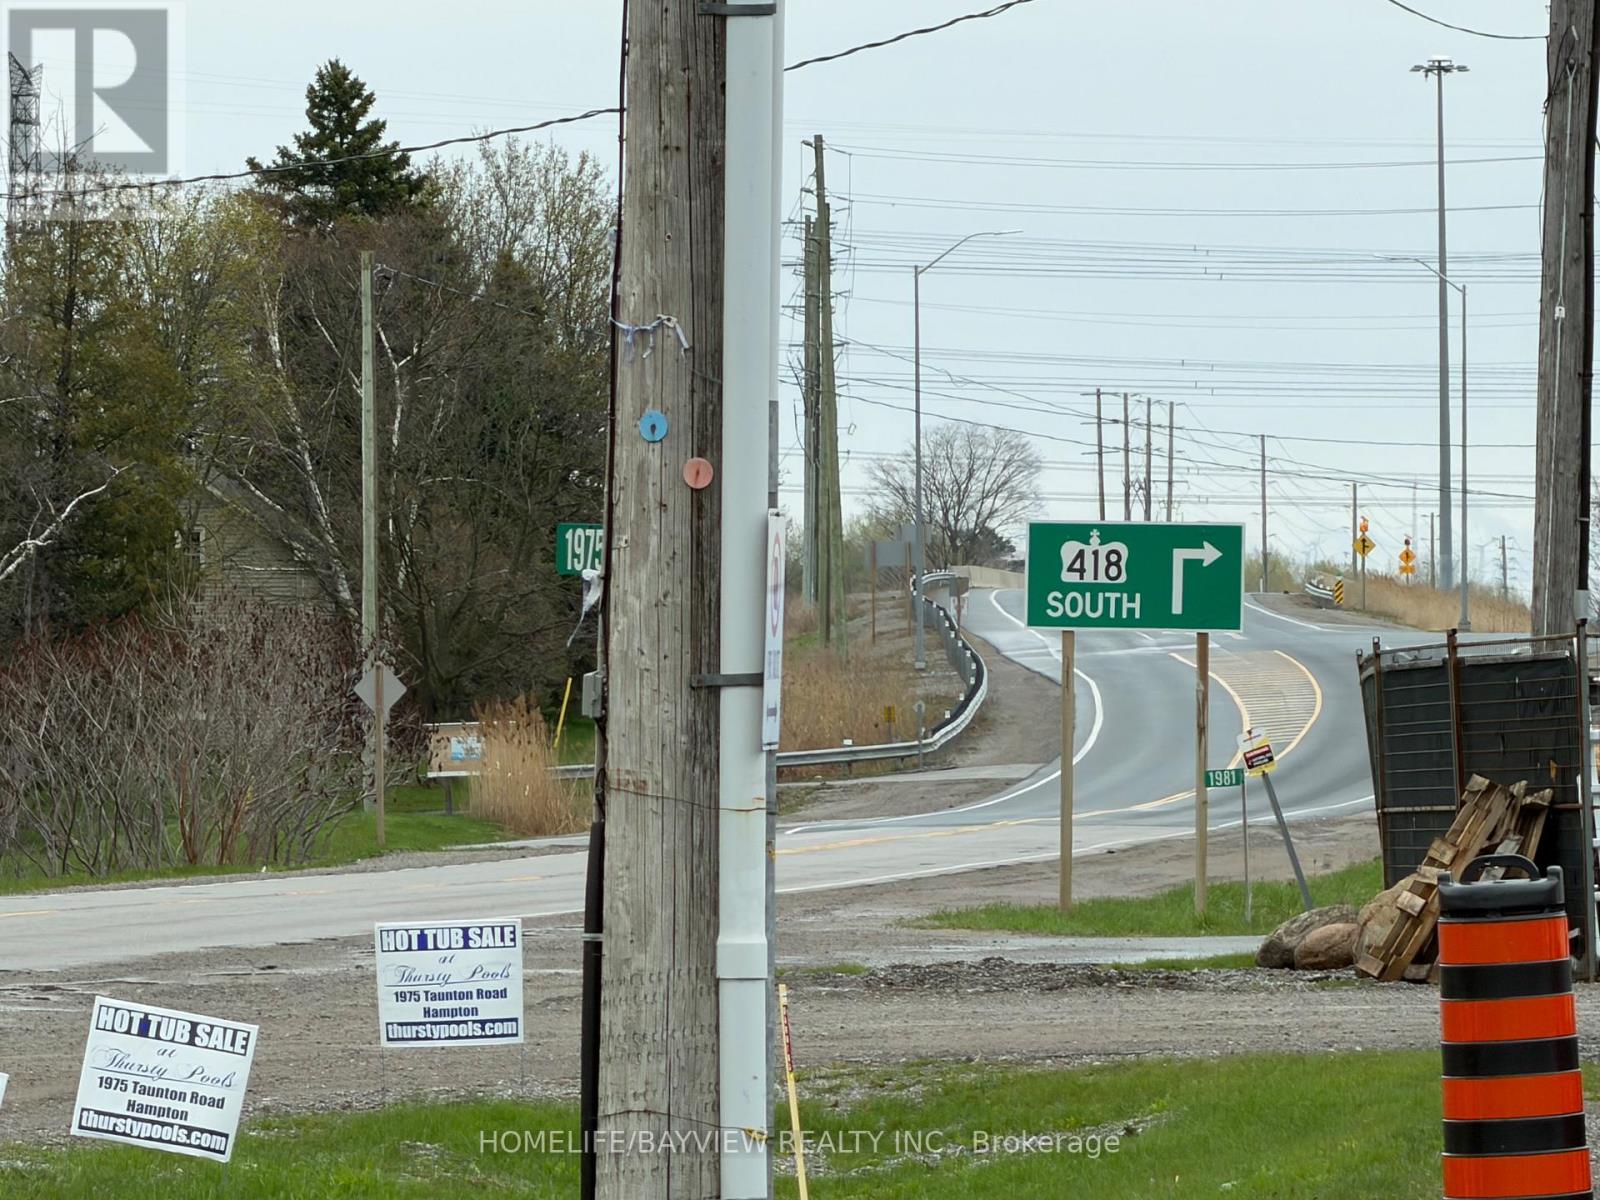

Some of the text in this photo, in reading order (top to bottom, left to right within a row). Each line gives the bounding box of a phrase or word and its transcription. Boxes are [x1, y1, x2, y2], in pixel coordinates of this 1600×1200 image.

[1066, 548, 1123, 581] 418
[1046, 591, 1140, 620] SOUTH
[1208, 771, 1236, 787] 1981
[382, 926, 515, 951] HOT TUB SALE
[438, 953, 455, 964] at
[393, 963, 512, 987] Thursty Pools
[394, 987, 508, 1003] 1975 Taunton Road
[423, 1006, 479, 1019] Hampton
[97, 1006, 249, 1054] HOT TUB SALE
[387, 1021, 517, 1039] thurstypools.com
[156, 1047, 177, 1058] at
[94, 1046, 237, 1088] Thursty Pools
[97, 1075, 225, 1110] 1975 Taunton Road
[126, 1099, 188, 1121] Hampton
[81, 1109, 227, 1151] thurstypools.com
